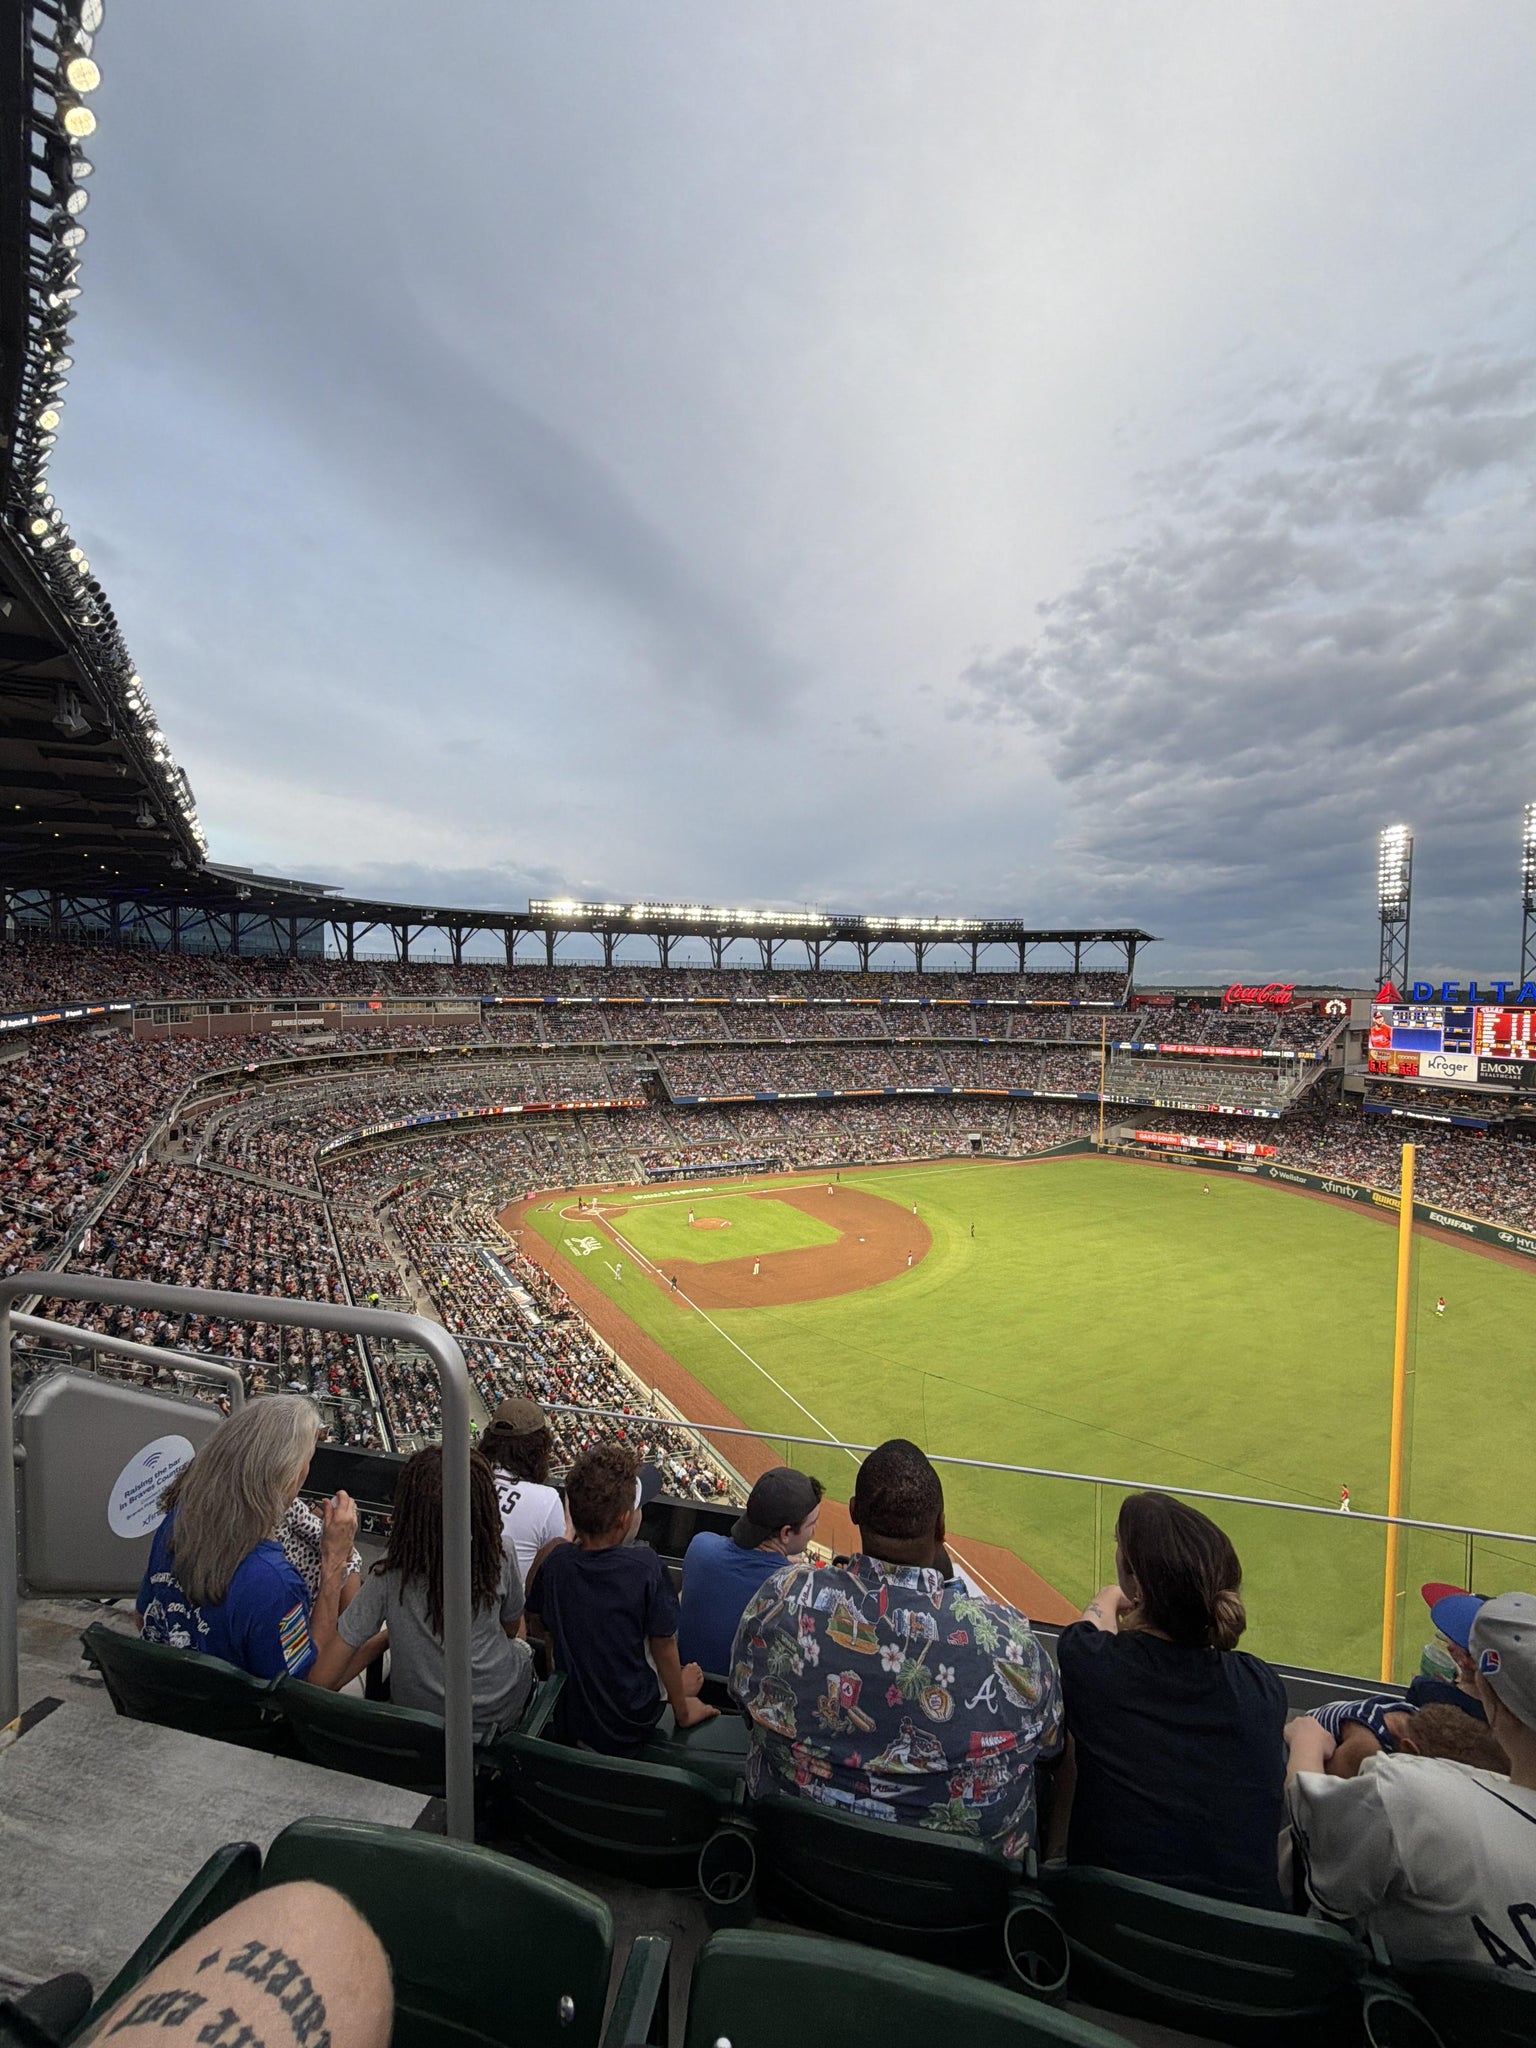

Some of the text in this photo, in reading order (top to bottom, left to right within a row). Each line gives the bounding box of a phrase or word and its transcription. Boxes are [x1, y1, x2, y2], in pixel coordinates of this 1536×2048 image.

[1224, 982, 1296, 1004] Coca-Cola
[1413, 981, 1536, 1003] DELTA
[1428, 1055, 1469, 1077] Kroger
[1480, 1062, 1524, 1075] EMORY
[1480, 1072, 1521, 1080] HEALTHCARE
[1279, 1170, 1307, 1184] Wellstar
[1321, 1180, 1358, 1199] xfinity
[1429, 1211, 1474, 1233] EQUIFAX
[124, 1457, 182, 1499] Raising the bar
[119, 1501, 128, 1511] in
[129, 1484, 156, 1504] Braves
